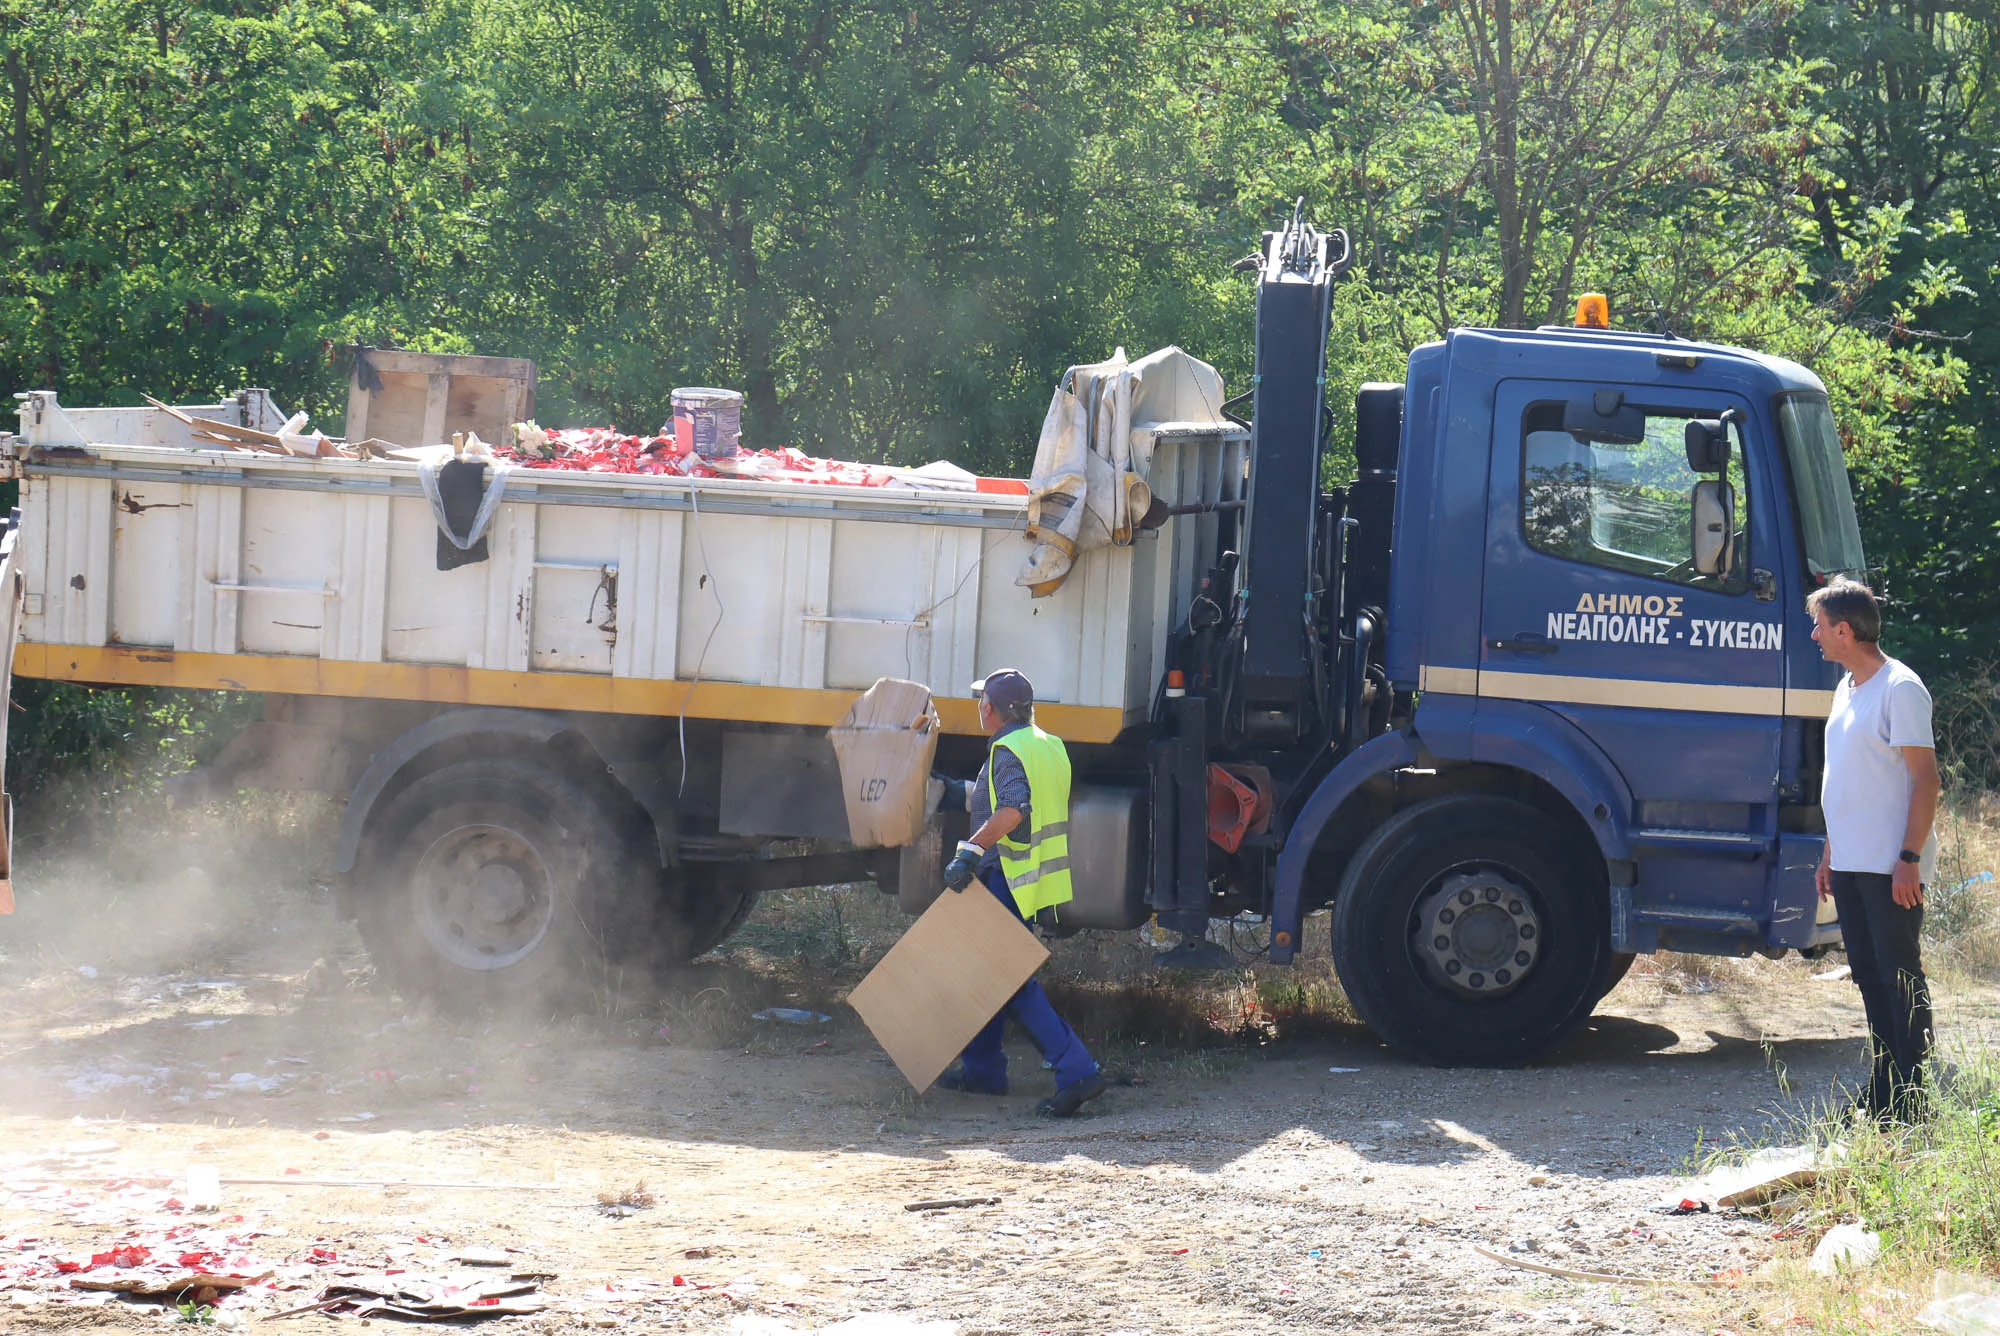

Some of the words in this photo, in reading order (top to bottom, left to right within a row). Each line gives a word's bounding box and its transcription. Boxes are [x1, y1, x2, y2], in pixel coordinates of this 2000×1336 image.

[1576, 592, 1684, 617] ΔΗΜΟΣ
[1547, 612, 1670, 645] ΝΕΑΠΟΛΗΣ
[1689, 619, 1783, 651] ΣΥΚΕΩΝ
[860, 778, 888, 803] LED
